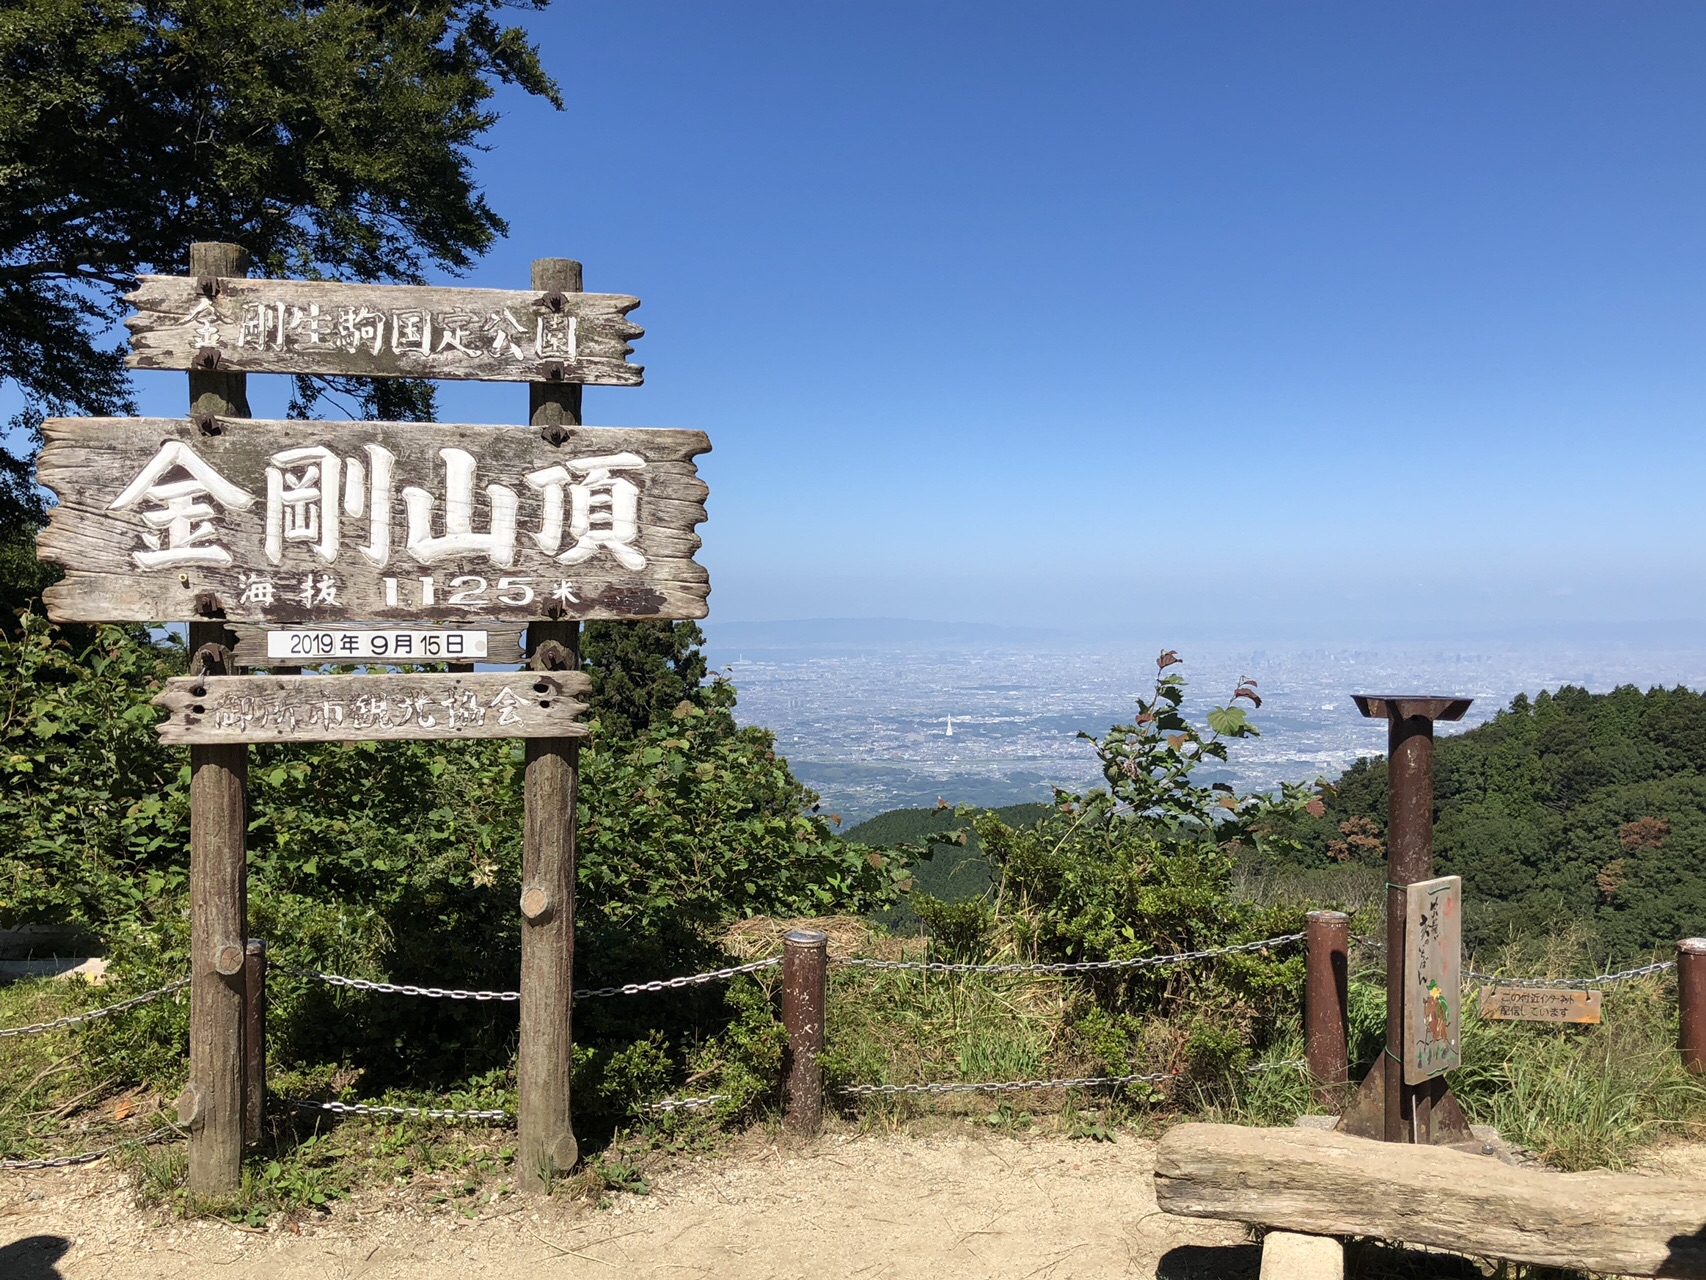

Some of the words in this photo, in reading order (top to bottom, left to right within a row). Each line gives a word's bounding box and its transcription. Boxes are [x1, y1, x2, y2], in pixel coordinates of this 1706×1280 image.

[177, 298, 577, 361] 金剛生駒国定公園
[107, 440, 647, 570] 金剛山頂
